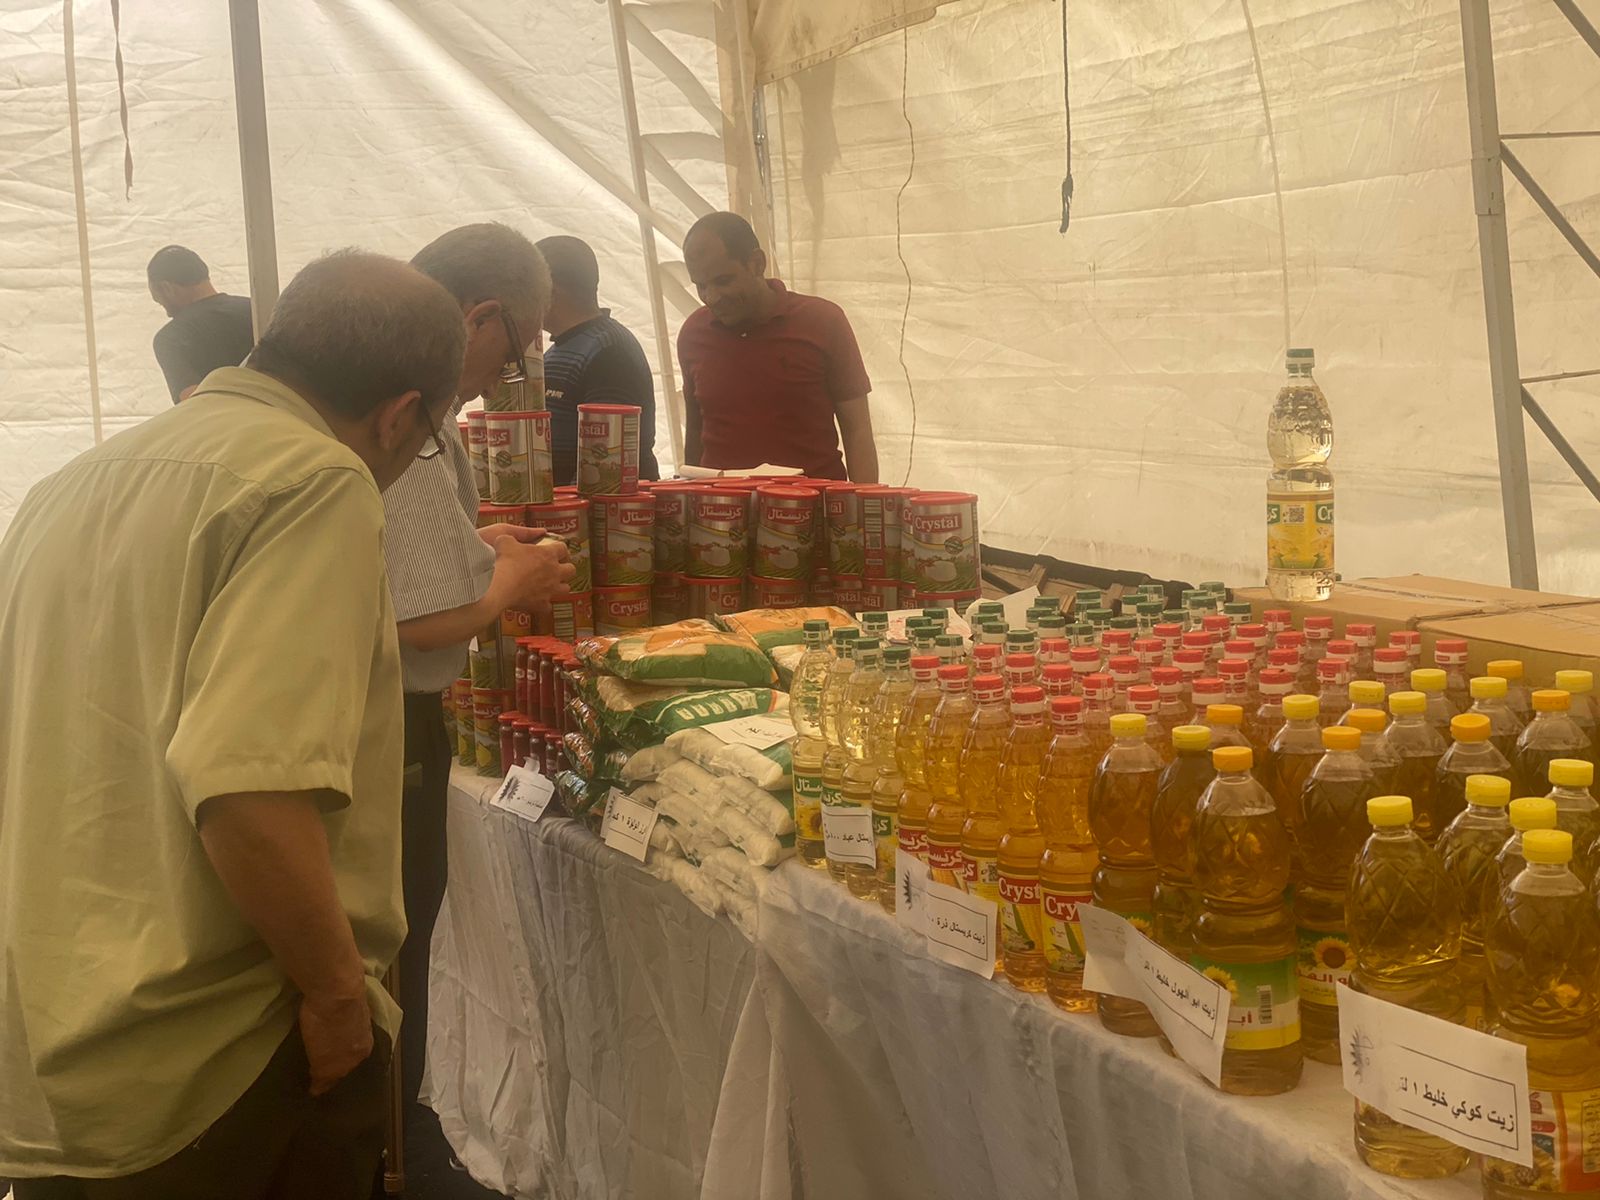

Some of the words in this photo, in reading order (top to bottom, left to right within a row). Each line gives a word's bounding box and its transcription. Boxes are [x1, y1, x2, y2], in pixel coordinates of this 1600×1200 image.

[915, 516, 960, 533] Crystal
[973, 932, 986, 946] زيت
[1201, 1003, 1216, 1021] زيت
[1423, 1083, 1448, 1107] خليط
[1451, 1100, 1482, 1121] كوكي
[1486, 1110, 1514, 1133] زيت
